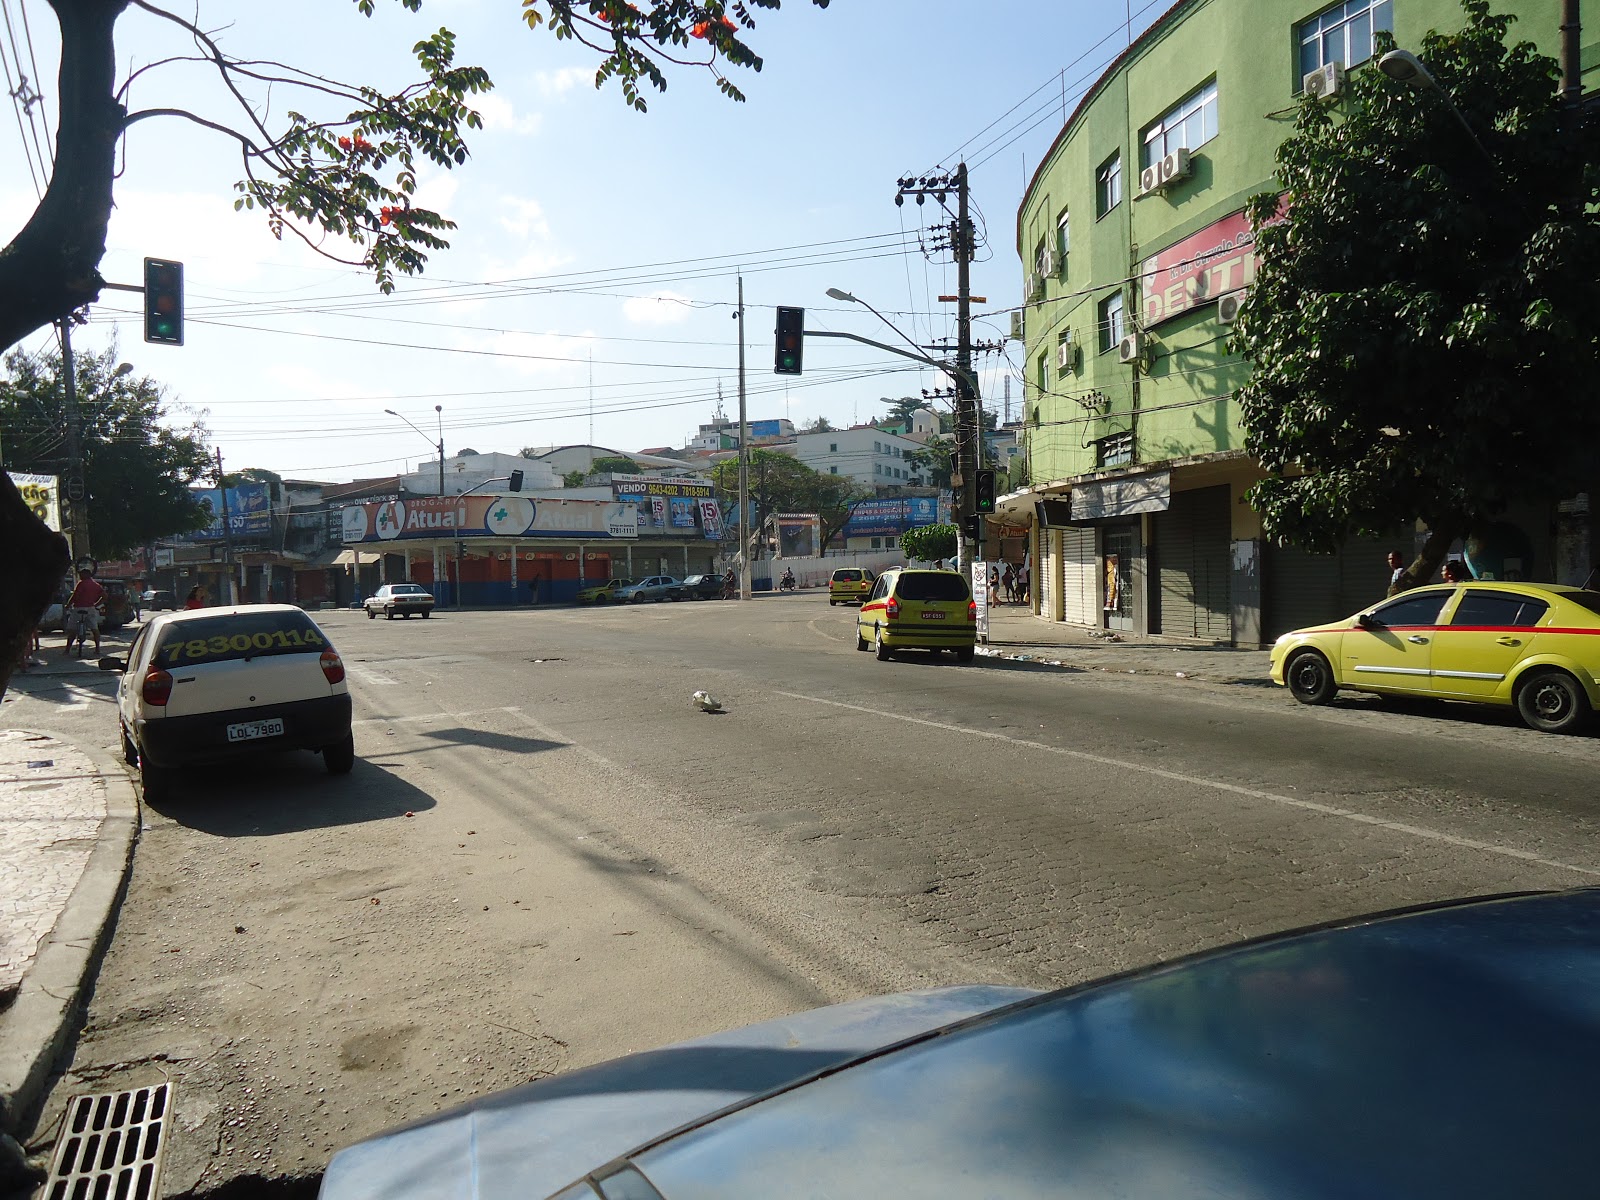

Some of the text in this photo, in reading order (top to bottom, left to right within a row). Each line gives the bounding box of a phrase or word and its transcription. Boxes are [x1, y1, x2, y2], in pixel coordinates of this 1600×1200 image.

[617, 483, 710, 497] VENDO 9643-4202 7818-5914
[652, 501, 663, 513] 15
[700, 502, 718, 519] 15
[407, 507, 466, 529] Atual
[536, 510, 593, 529] Atual
[162, 628, 322, 662] 78300114
